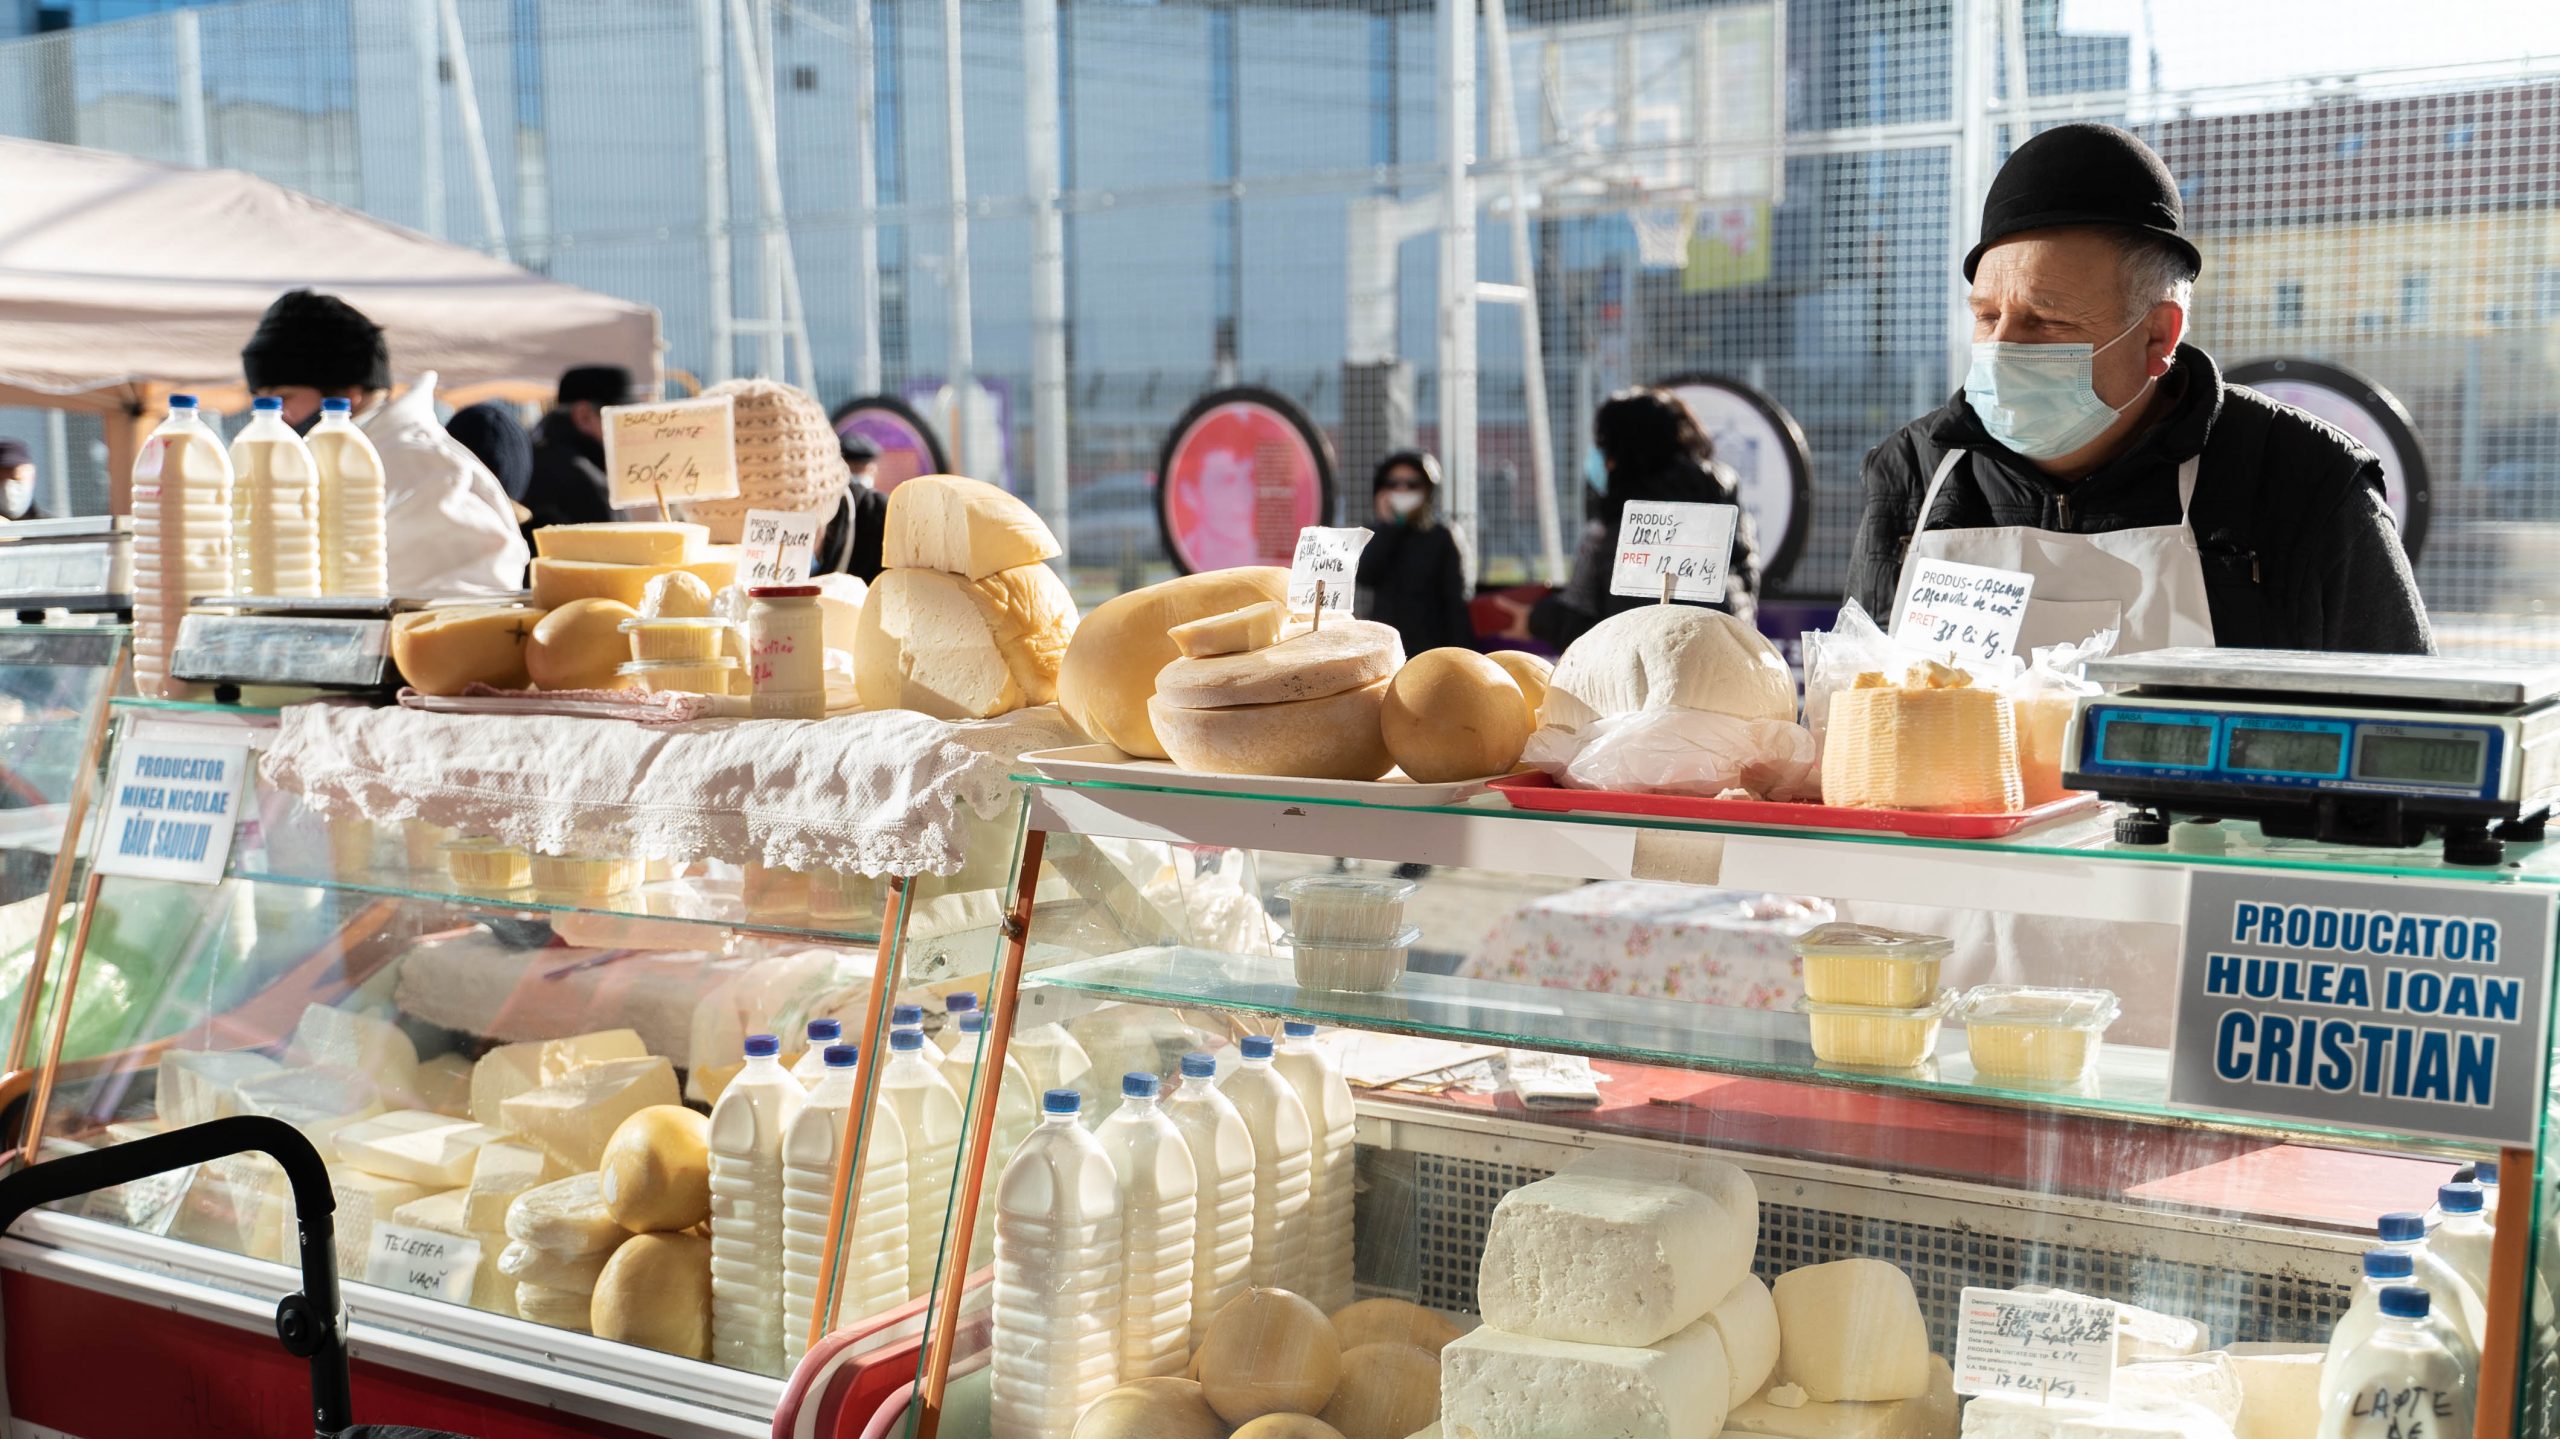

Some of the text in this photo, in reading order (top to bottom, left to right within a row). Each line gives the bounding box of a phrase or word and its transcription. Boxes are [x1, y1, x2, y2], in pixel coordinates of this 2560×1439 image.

[750, 518, 779, 529] PRODUS
[1629, 513, 1673, 526] PRODUS
[1622, 552, 1651, 567] PRET
[1908, 611, 1939, 627] PRET
[2117, 712, 2142, 721] MASA
[135, 754, 225, 782] PRODUCATOR
[119, 785, 230, 814] MINEA NICOLAE
[2233, 901, 2500, 963] PRODUCATOR
[2205, 953, 2523, 1023] HULEA IOAN
[2215, 1010, 2499, 1108] CRISTIAN
[384, 1233, 445, 1258] TELEMEA
[1995, 1374, 2012, 1387] 17
[2352, 1386, 2454, 1418] LAPTE
